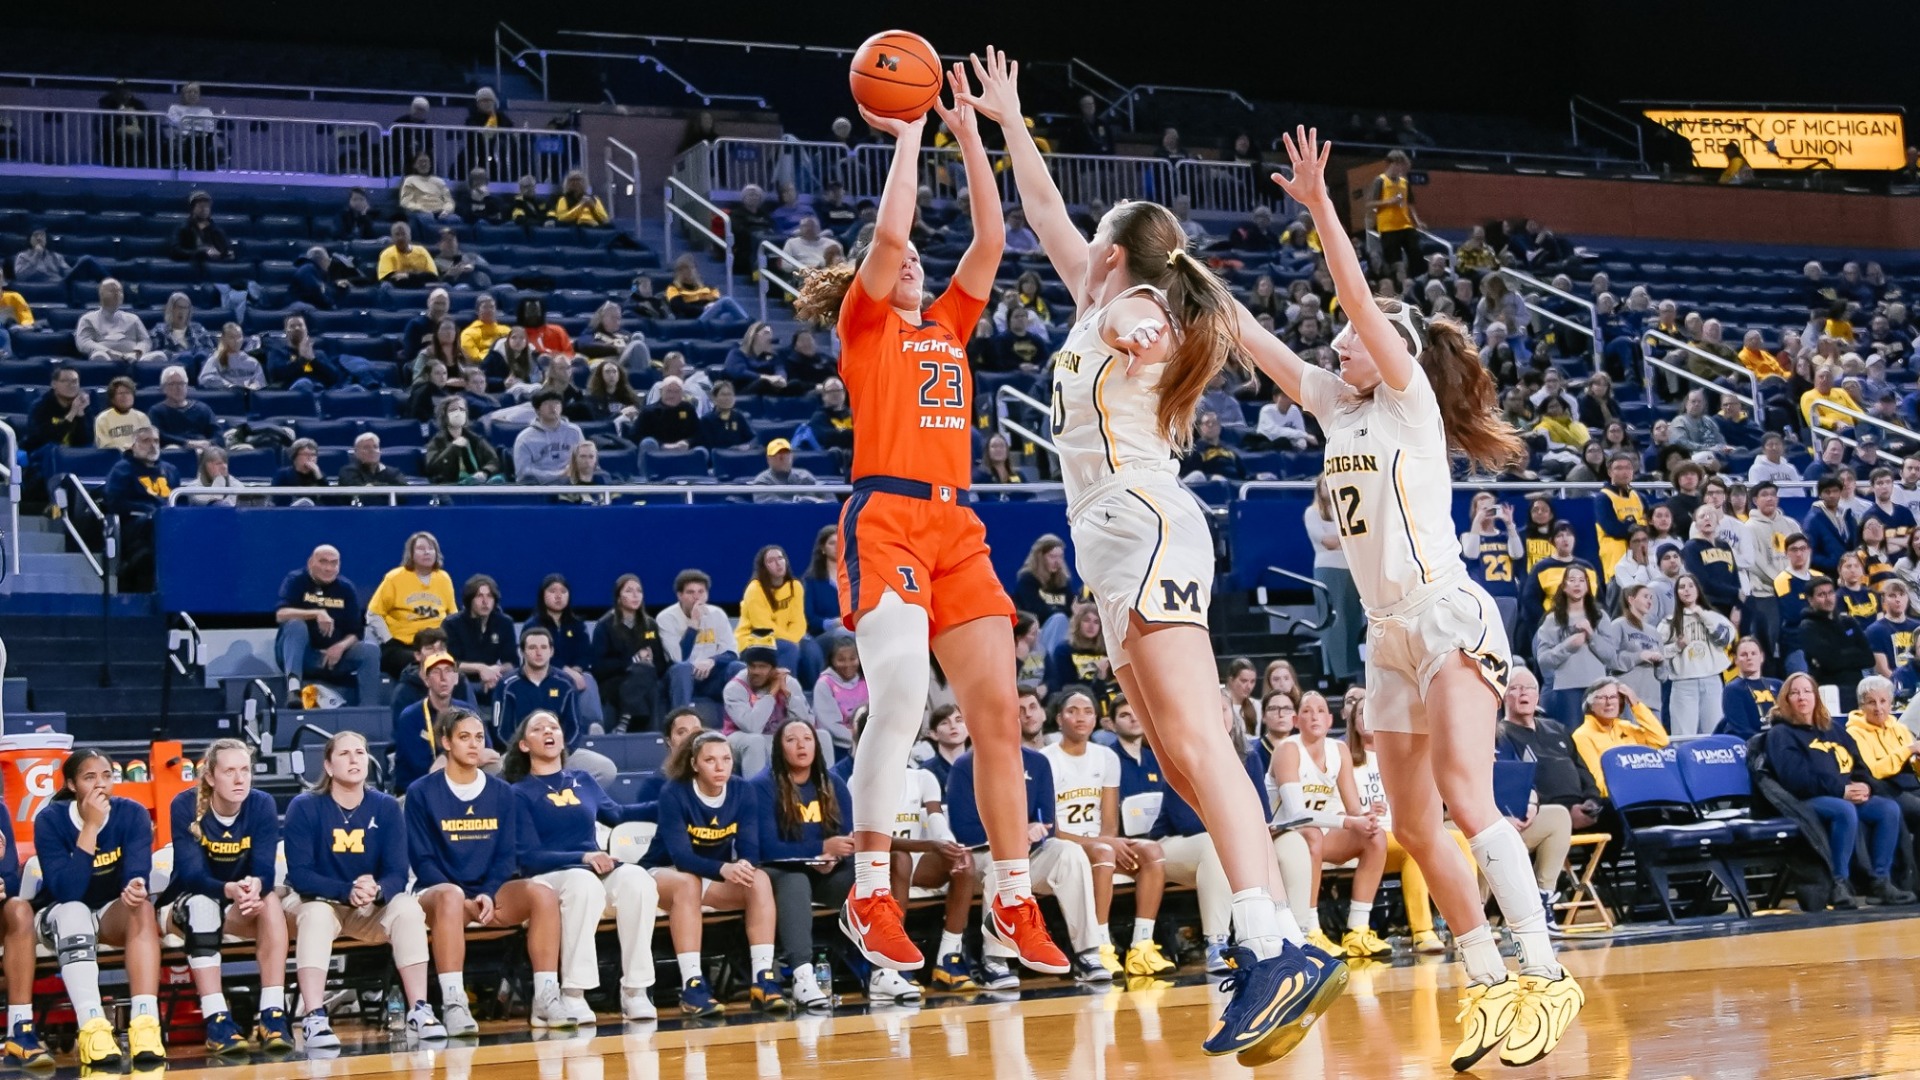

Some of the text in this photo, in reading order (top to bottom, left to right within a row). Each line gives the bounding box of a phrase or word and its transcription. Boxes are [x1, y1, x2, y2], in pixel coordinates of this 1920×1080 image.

[875, 52, 898, 72] M
[1772, 118, 1797, 136] OF
[1803, 119, 1898, 137] MICHIGAN
[1790, 139, 1853, 156] UNION
[901, 339, 964, 359] FIGHTNG
[918, 361, 965, 409] 23
[919, 415, 966, 430] ILLINI
[1482, 553, 1513, 582] 23
[1159, 579, 1202, 614] M
[1627, 752, 1663, 765] UMCU
[1701, 748, 1735, 760] UMCU
[25, 764, 55, 797] G
[1364, 784, 1380, 796] TO
[546, 787, 582, 807] M
[798, 800, 823, 823] M
[1066, 803, 1096, 824] 22
[441, 818, 498, 831] MICHIGAN
[687, 822, 738, 840] MICHIGAN
[332, 828, 365, 853] M
